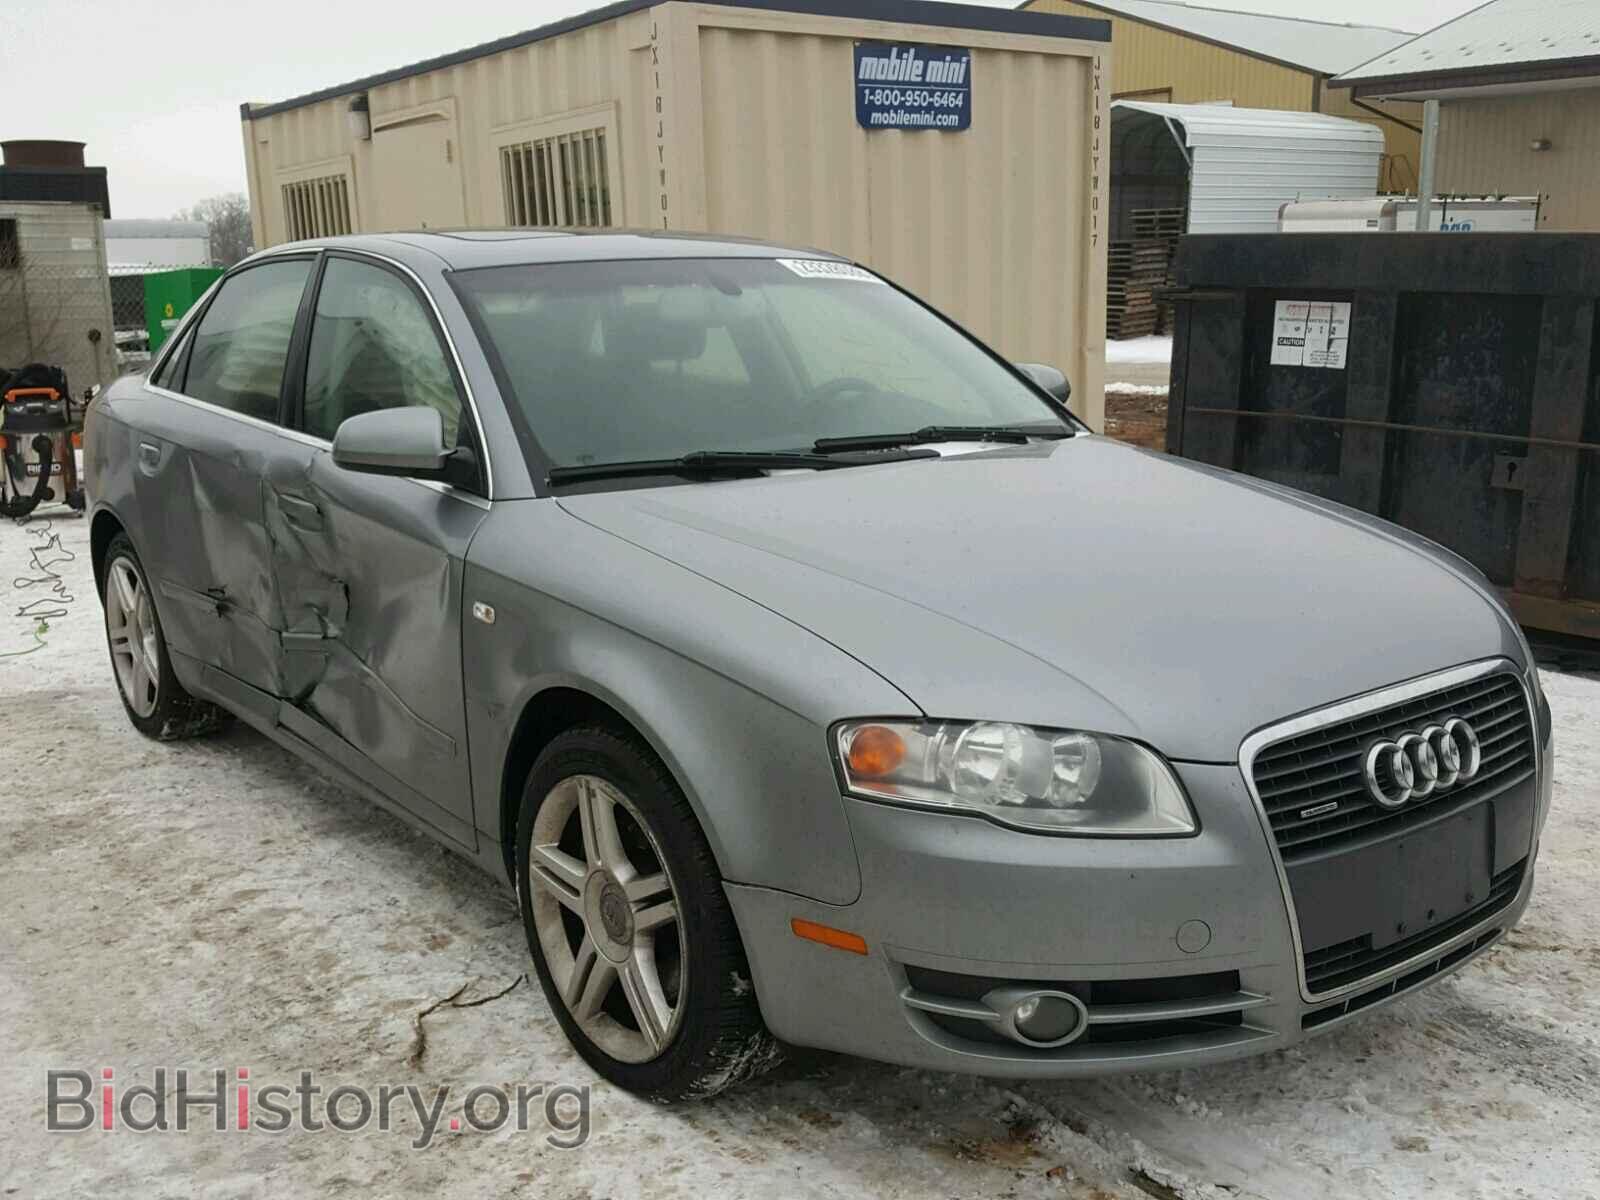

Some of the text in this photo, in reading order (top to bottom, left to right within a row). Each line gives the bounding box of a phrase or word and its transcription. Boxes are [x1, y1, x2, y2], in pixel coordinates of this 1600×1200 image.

[859, 47, 968, 84] mobile mini
[864, 88, 963, 107] 1-800-950-6464
[870, 109, 959, 126] mobilemini.com
[1279, 338, 1304, 346] CAUTION
